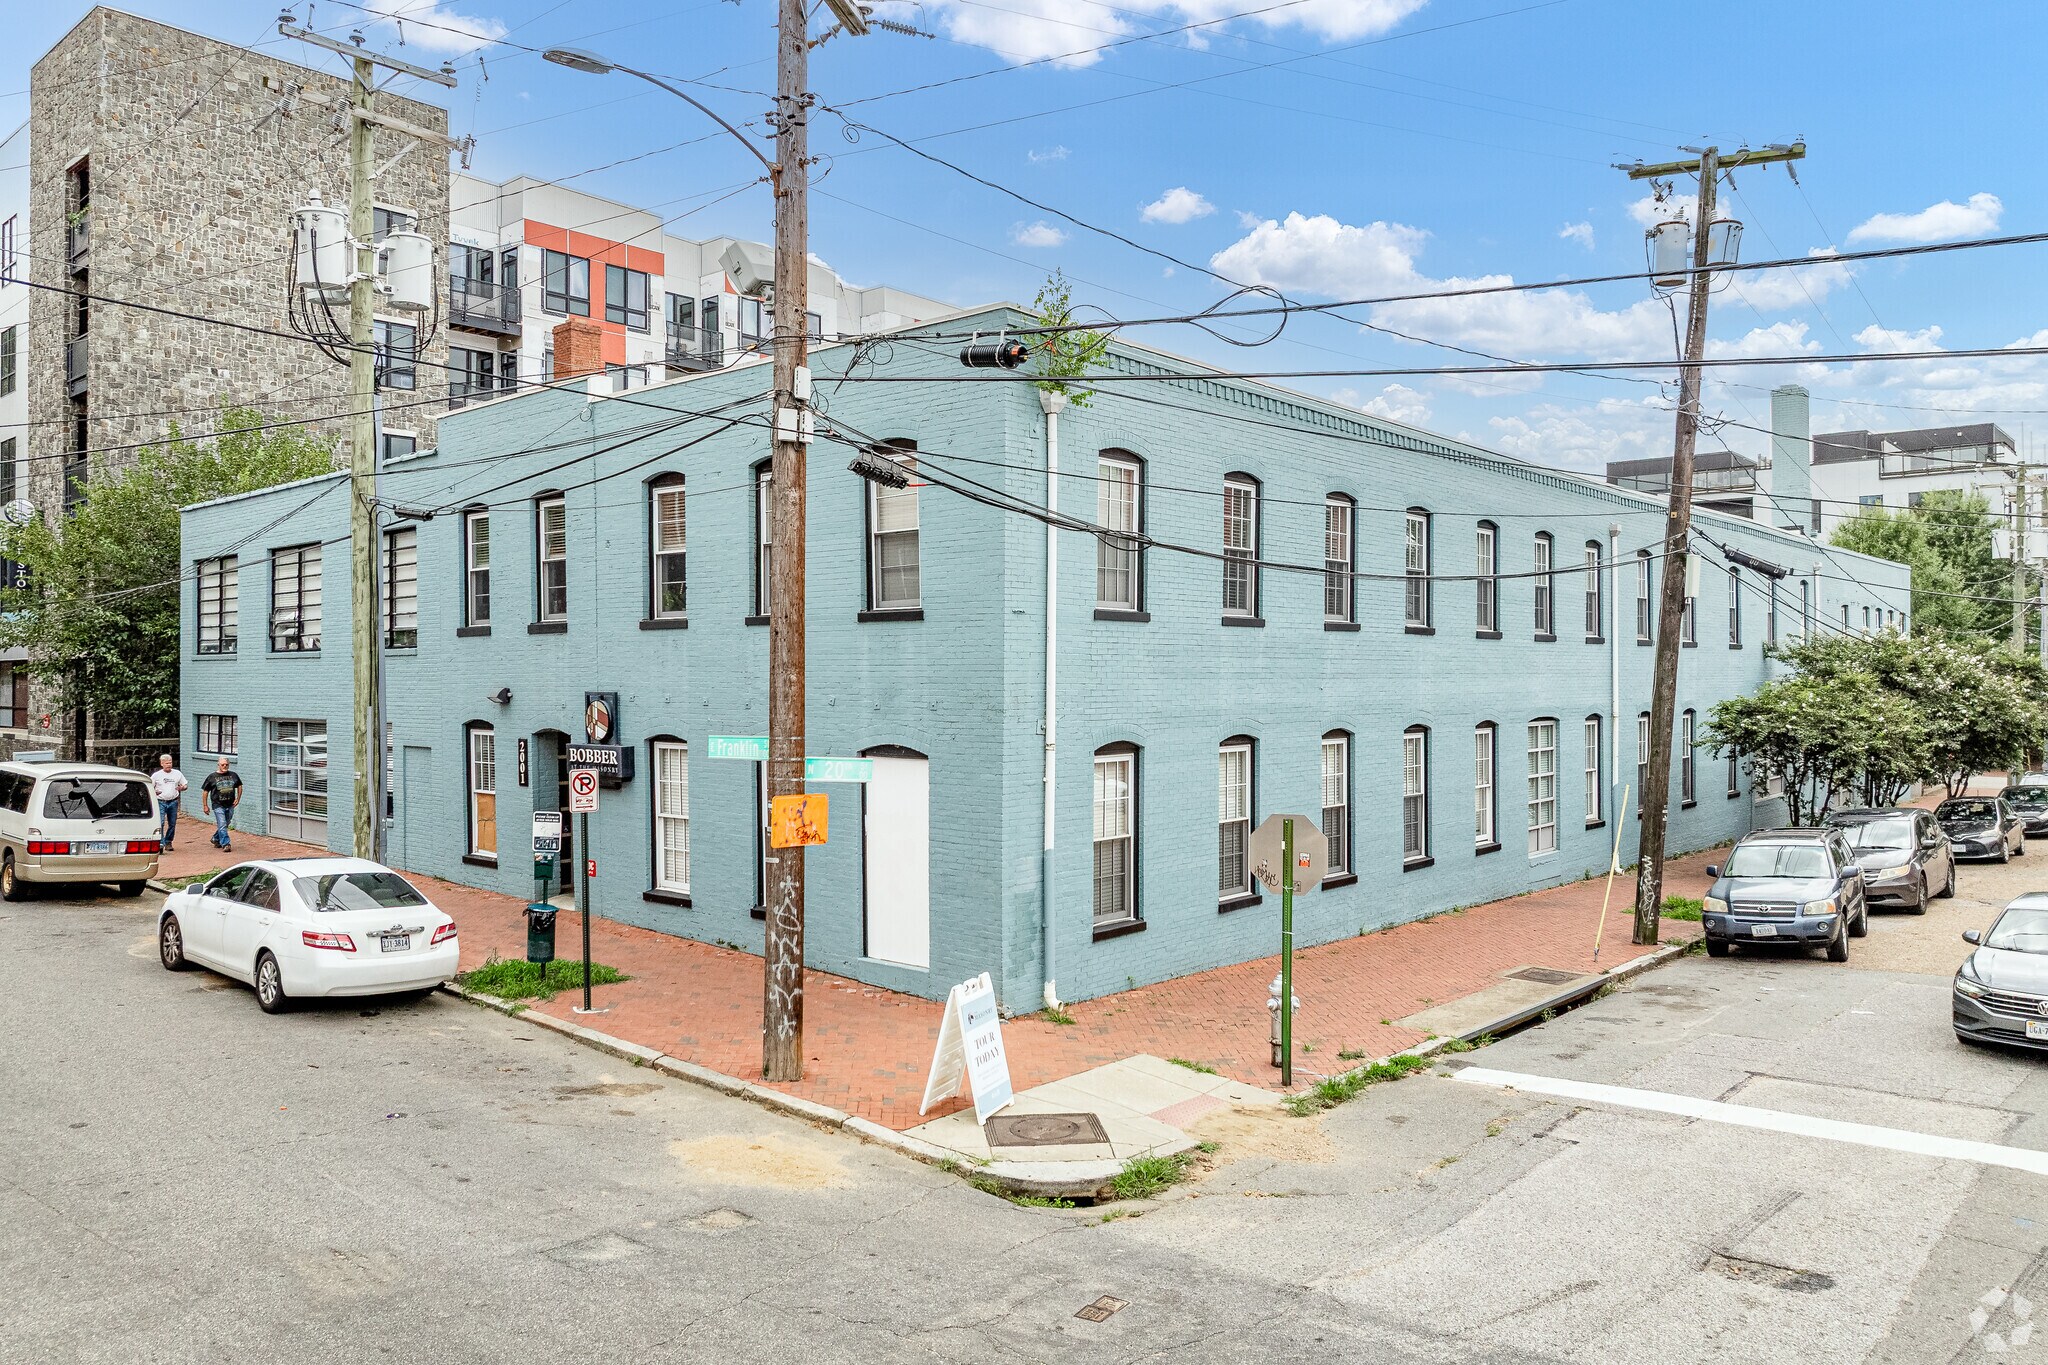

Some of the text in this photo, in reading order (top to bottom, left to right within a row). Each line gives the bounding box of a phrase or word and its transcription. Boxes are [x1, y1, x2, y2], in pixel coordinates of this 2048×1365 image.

[569, 748, 618, 765] BOBBER
[717, 739, 759, 757] Franklin
[808, 764, 814, 775] N
[974, 1032, 995, 1049] TOUR
[975, 1047, 999, 1067] TODAY
